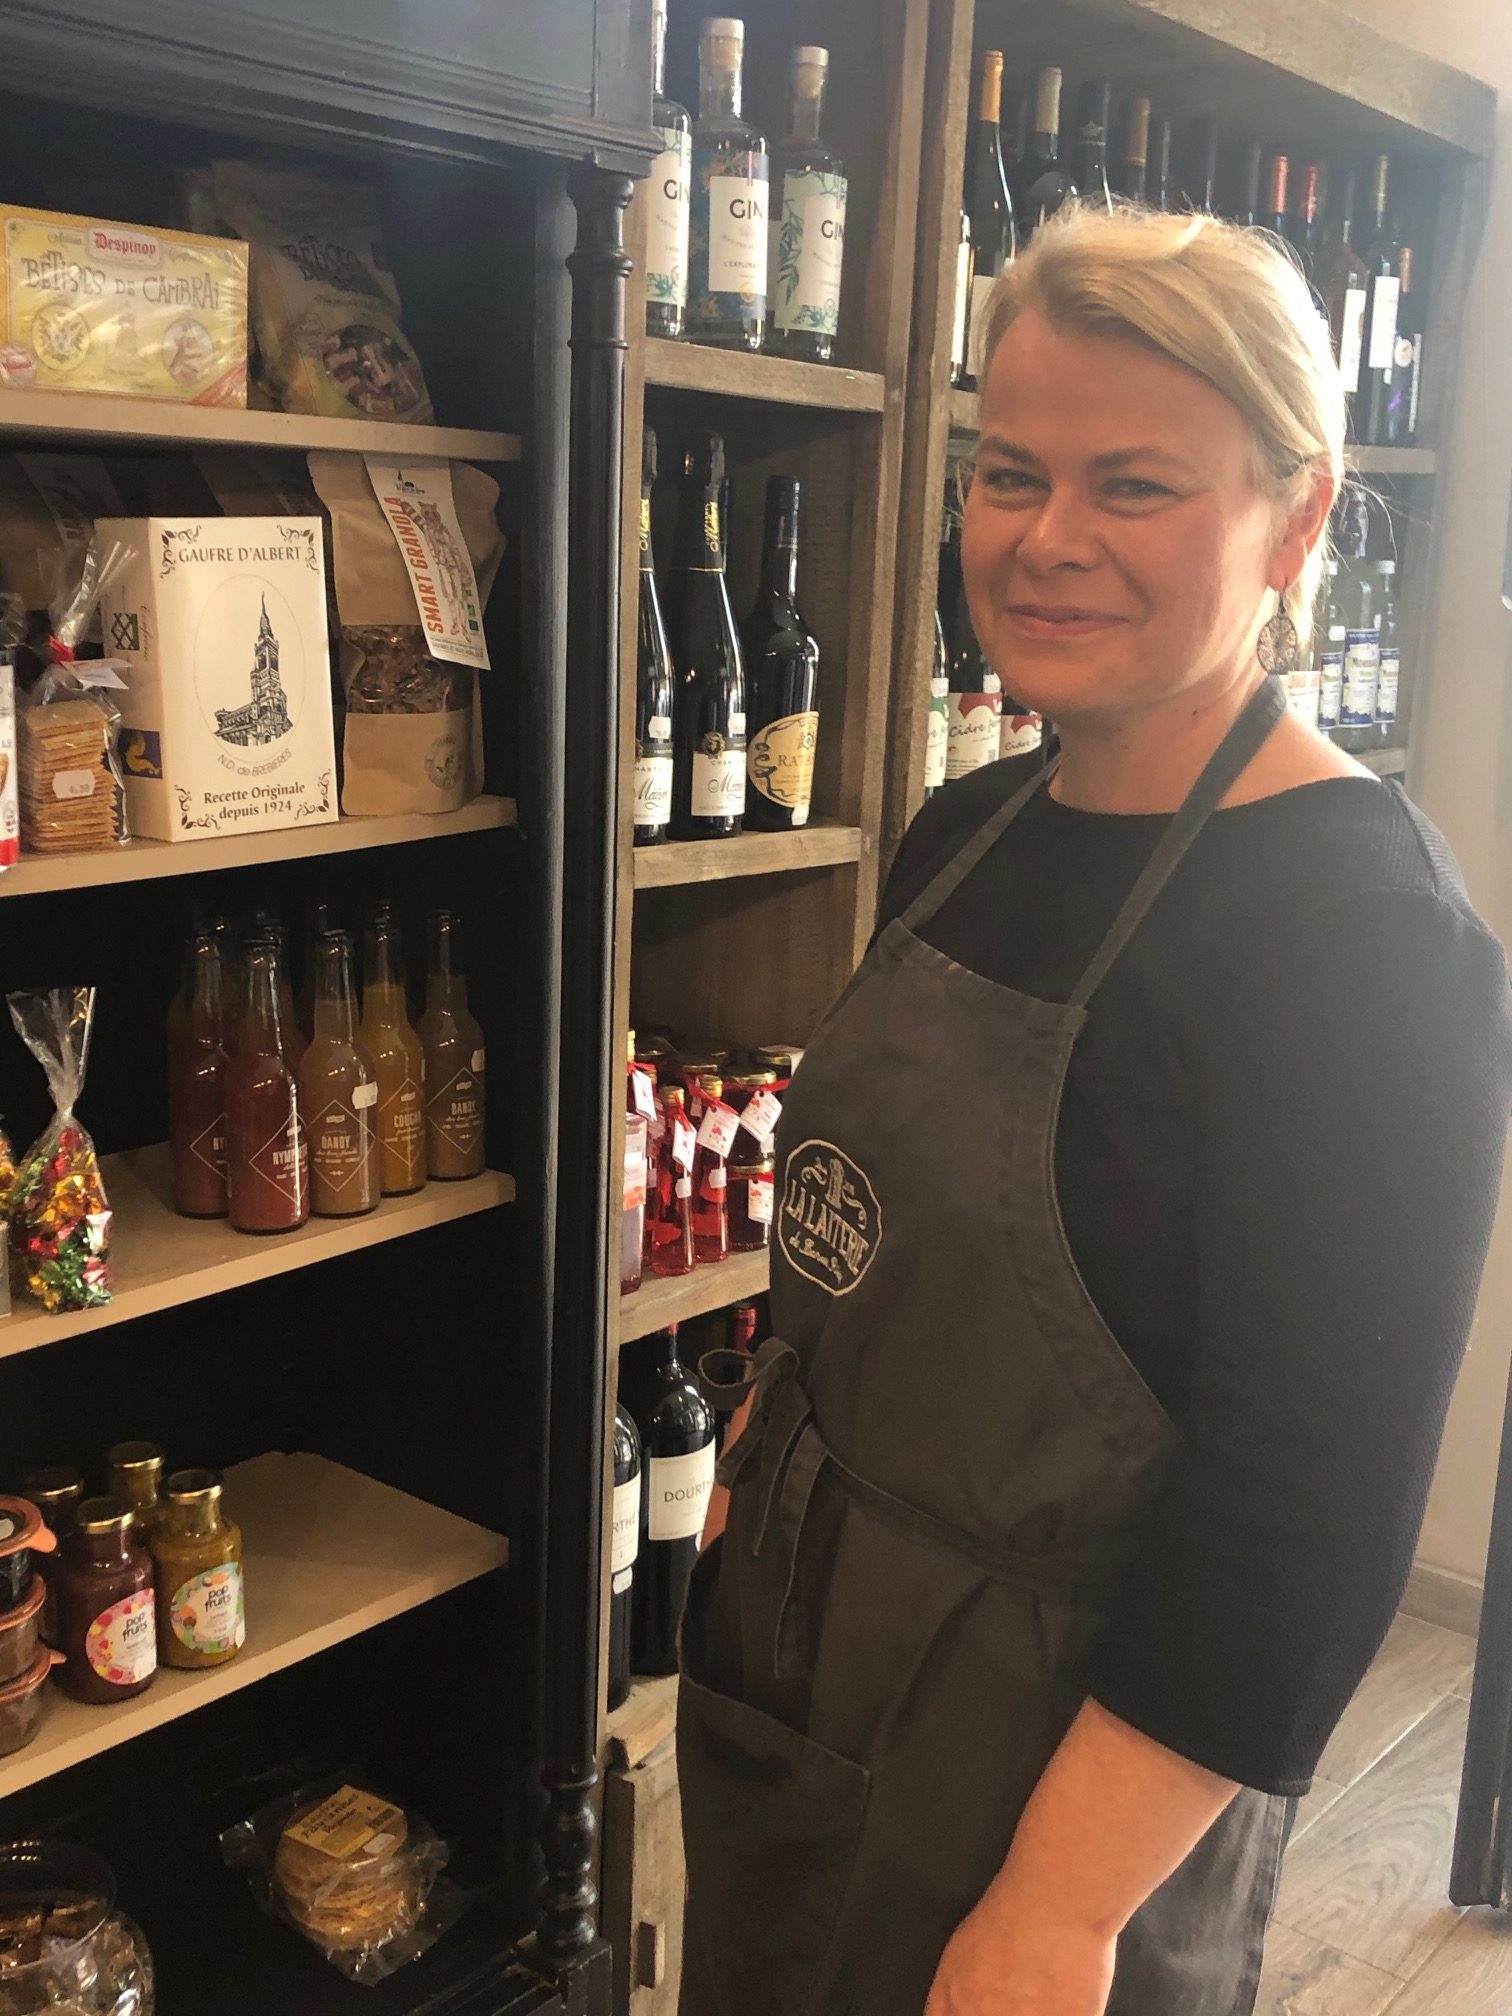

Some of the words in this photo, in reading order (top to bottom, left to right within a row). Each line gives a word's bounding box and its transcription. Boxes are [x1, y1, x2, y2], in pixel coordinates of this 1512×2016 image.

[730, 199, 763, 220] GIN
[94, 232, 156, 255] Despinoy
[115, 279, 135, 296] DE
[384, 495, 429, 570] GRANOLA
[178, 548, 234, 562] GAUFRE
[238, 546, 300, 561] D'ALBERT
[415, 573, 444, 634] SMART
[949, 723, 984, 737] Cidre
[204, 790, 248, 804] Recette
[251, 781, 305, 800] Originale
[219, 803, 259, 821] depuis
[263, 800, 292, 814] 1924
[451, 1101, 477, 1115] DANDY
[321, 1135, 350, 1150] DANDY
[784, 1179, 806, 1222] LA
[208, 1585, 229, 1599] pop
[204, 1594, 232, 1612] fruits
[125, 1612, 146, 1629] pop
[122, 1620, 148, 1642] fruits
